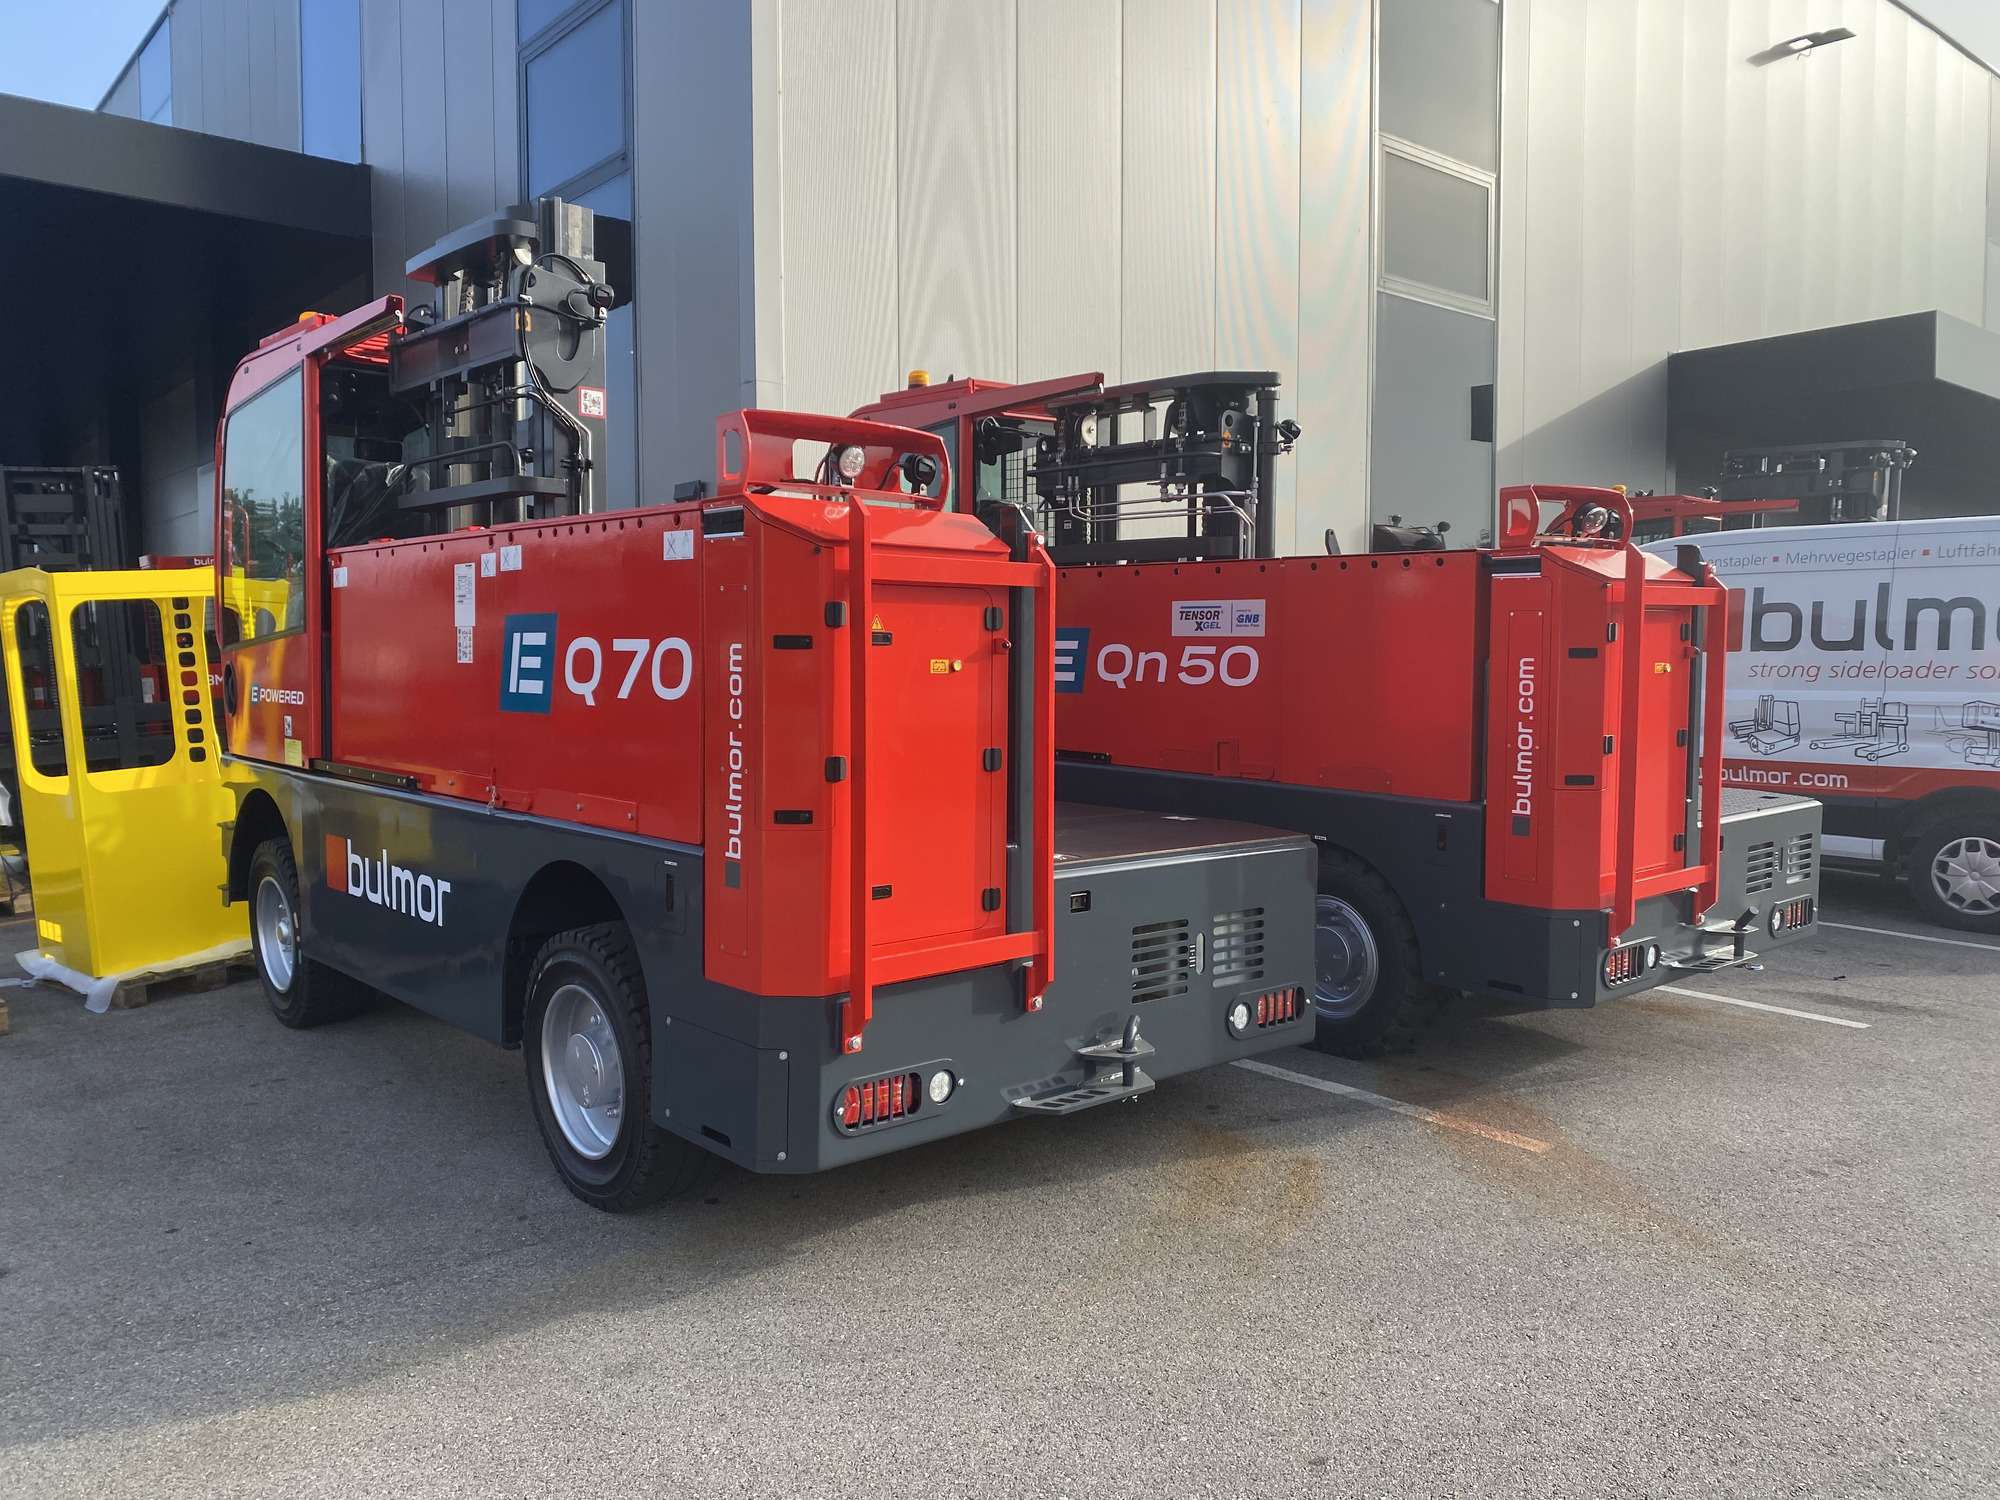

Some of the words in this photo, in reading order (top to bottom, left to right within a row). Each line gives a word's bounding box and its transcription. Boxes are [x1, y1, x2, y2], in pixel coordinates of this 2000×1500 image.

[1707, 553, 1768, 570] enstapler
[1785, 547, 1917, 567] Mehrwegestapler
[1179, 610, 1220, 621] TENSOR
[1236, 614, 1260, 623] GNB
[1750, 581, 2000, 652] bulm
[1097, 643, 1168, 689] Qn
[1178, 645, 1260, 687] 50
[1748, 662, 1822, 683] strong
[1828, 659, 1960, 680] sideloader
[1965, 664, 2000, 681] so
[260, 688, 304, 705] POWERED
[725, 643, 742, 859] bulmor.com
[1511, 657, 1535, 815] bulmor.com
[347, 838, 450, 927] bulmor
